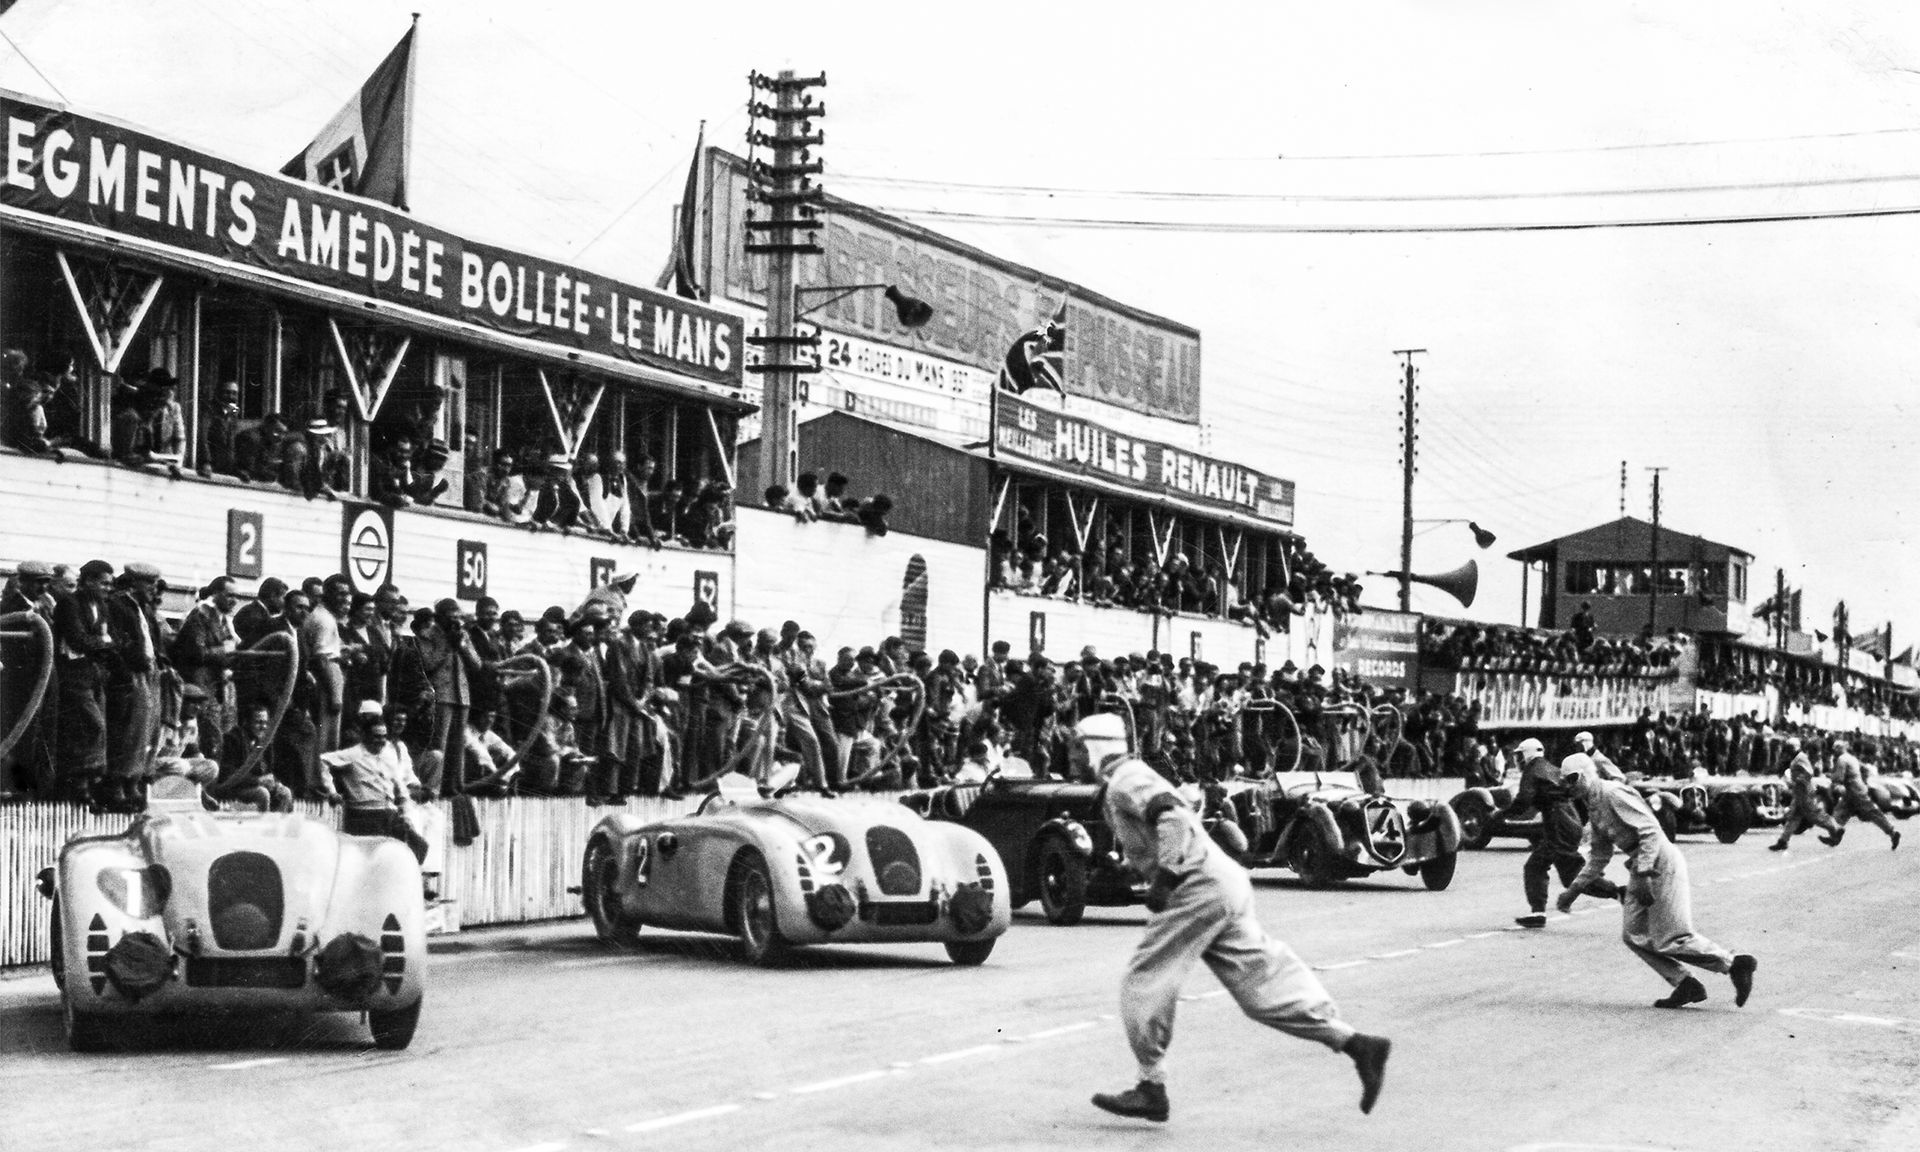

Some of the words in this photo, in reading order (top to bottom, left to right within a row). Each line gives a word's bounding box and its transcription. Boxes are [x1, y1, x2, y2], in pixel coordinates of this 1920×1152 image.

[8, 116, 257, 247] EGMENTS
[278, 197, 444, 299] AMÉDÉE
[654, 305, 731, 371] MANS
[829, 339, 852, 367] 24
[897, 357, 911, 380] DU
[916, 360, 944, 389] MANS
[1056, 419, 1148, 481] HUILES
[1161, 450, 1258, 508] RENAULT
[239, 522, 255, 564] 2
[463, 551, 485, 588] 50
[1358, 658, 1406, 678] RECORDS
[804, 835, 843, 874] 2
[121, 871, 143, 918] 1
